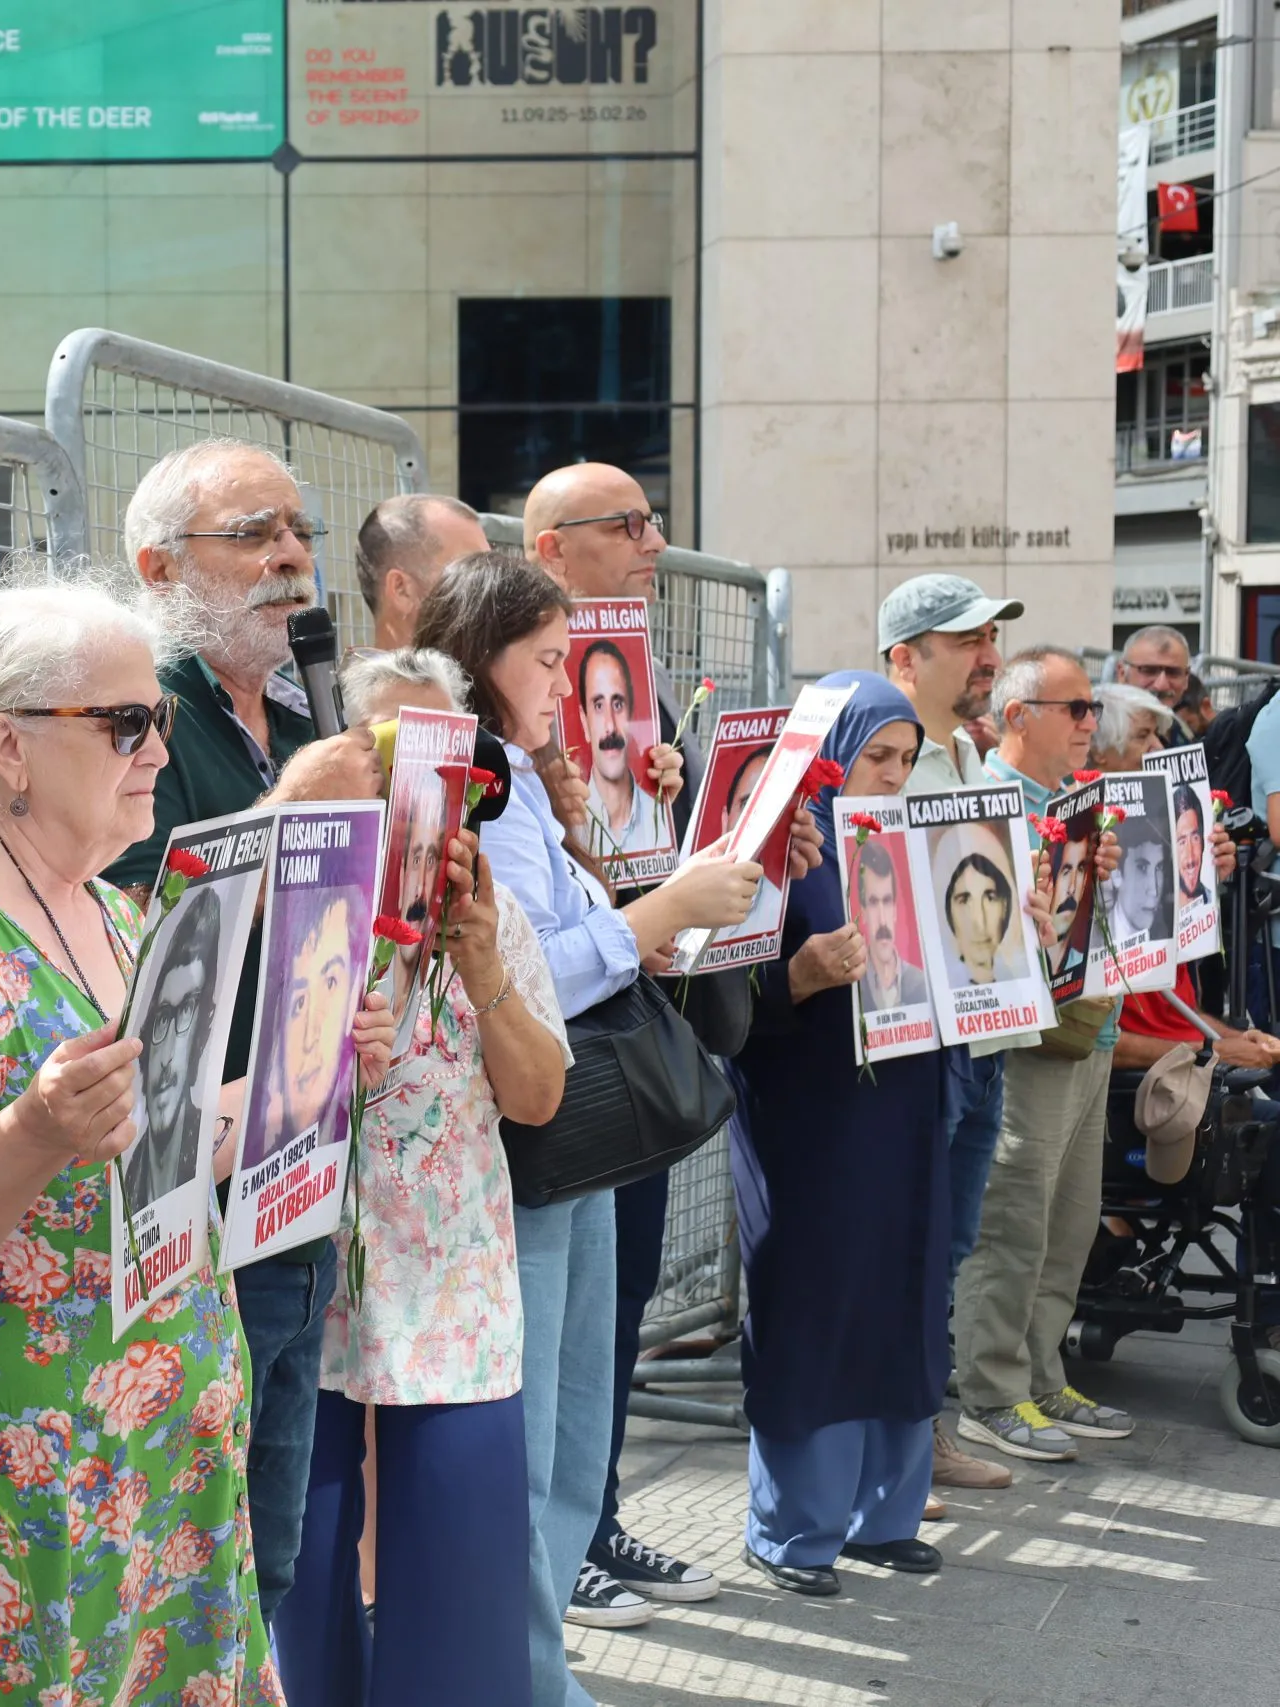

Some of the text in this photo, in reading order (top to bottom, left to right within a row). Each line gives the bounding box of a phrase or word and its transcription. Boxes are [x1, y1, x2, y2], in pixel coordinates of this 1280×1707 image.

[306, 48, 376, 63] DO YOU
[306, 68, 406, 83] REMEMBER
[307, 88, 408, 105] THE SCENT
[33, 106, 81, 129] THE
[88, 106, 151, 129] DEER
[306, 108, 420, 126] OF SPRING?
[886, 525, 1071, 553] yapı kredi kültür sanat
[568, 603, 646, 630] NAN BİLGİN
[400, 722, 435, 751] KENAN
[718, 717, 772, 741] KENAN
[1180, 750, 1206, 782] OCAK
[909, 792, 1020, 825] KADRİYE TATU
[233, 827, 271, 867] EREN
[280, 854, 320, 885] YAMAN
[1179, 907, 1217, 948] BEDİLDİ
[956, 1001, 1038, 1036] KAYBEDİLDİ
[241, 1179, 249, 1200] 5
[250, 1157, 280, 1195] MAYIS
[257, 1158, 310, 1213] GÖZALTINDA
[123, 1223, 160, 1269] GÖLTINDA
